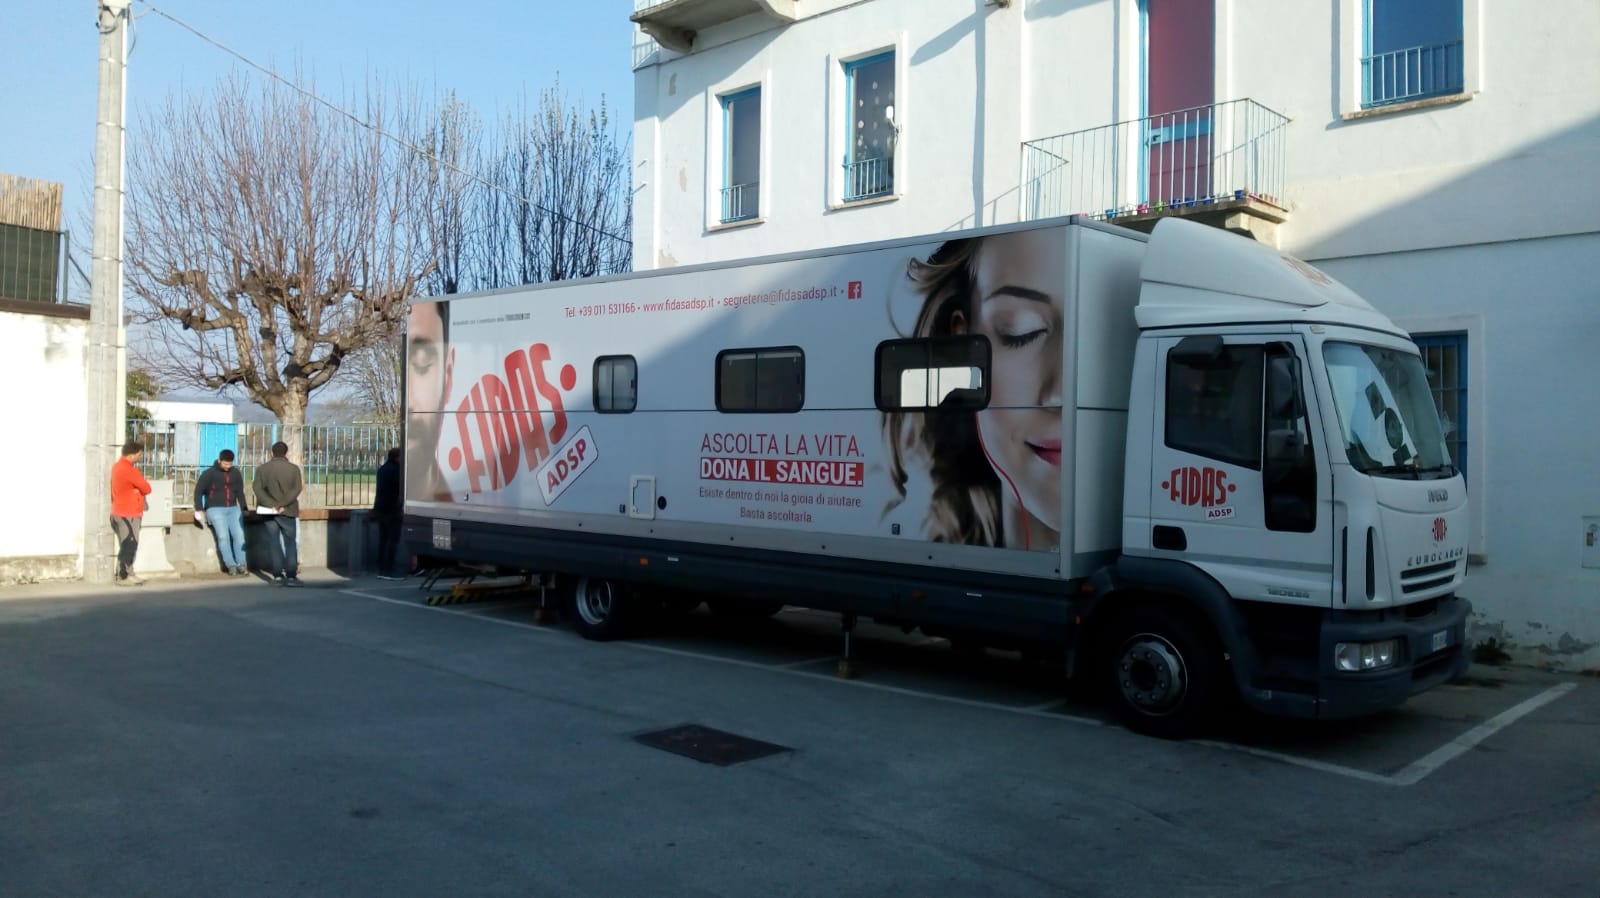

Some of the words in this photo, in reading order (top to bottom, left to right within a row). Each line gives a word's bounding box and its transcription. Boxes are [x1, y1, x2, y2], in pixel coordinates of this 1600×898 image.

[579, 305, 592, 317] +39
[593, 304, 606, 316] 011
[608, 302, 635, 315] 531166
[643, 297, 715, 313] www.fidasadsp.it
[723, 285, 837, 308] segreteria@fidasadsp.it
[456, 343, 567, 493] FIDAS
[700, 433, 779, 455] ASCOLTA
[785, 434, 808, 456] LA
[815, 434, 865, 458] VITA.
[547, 438, 587, 494] ADSP
[701, 458, 750, 480] DONA
[755, 460, 771, 481] IL
[776, 460, 863, 486] SANGUE.
[699, 486, 724, 498] Esiste
[725, 488, 753, 501] dentro
[755, 490, 764, 501] di
[765, 492, 779, 502] noi
[780, 490, 789, 503] la
[791, 495, 814, 506] gioia
[816, 493, 825, 505] di
[827, 496, 861, 508] aiutare
[1170, 466, 1227, 508] FIDAS
[740, 506, 765, 520] Basta
[1208, 508, 1232, 518] ADSP
